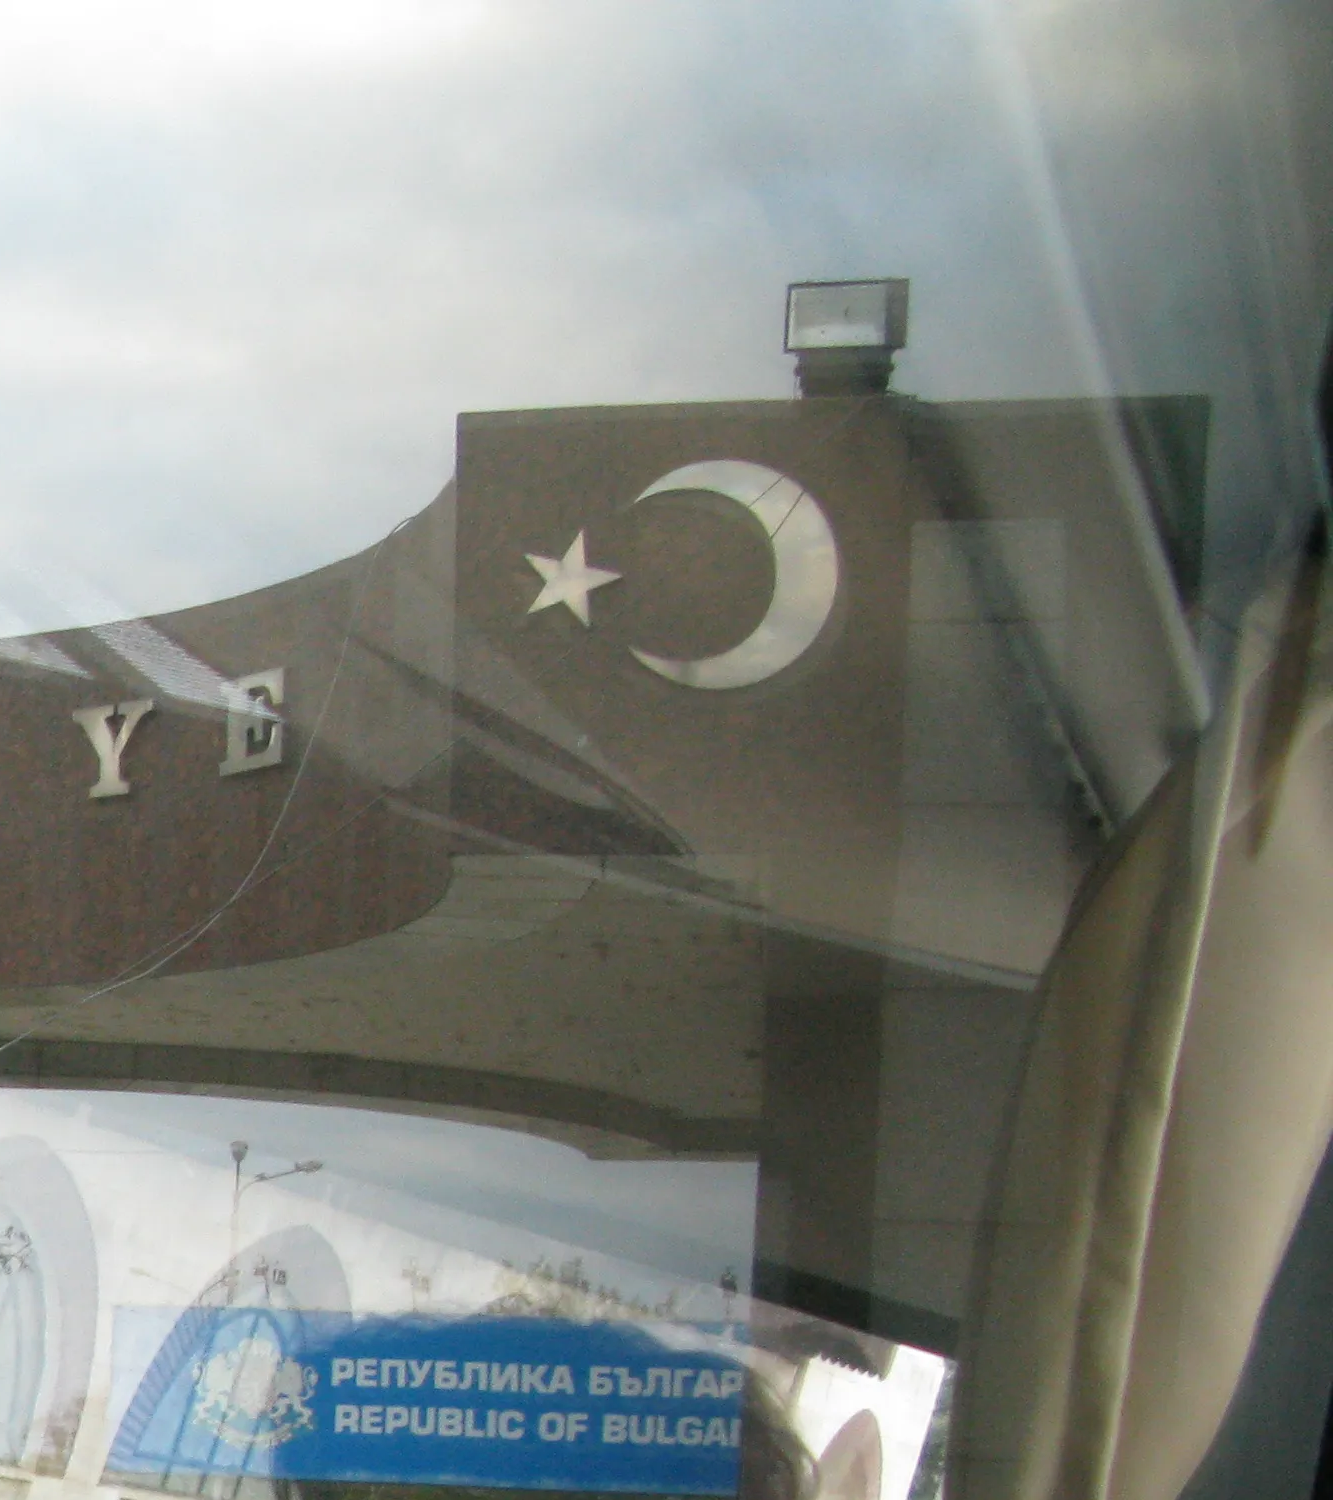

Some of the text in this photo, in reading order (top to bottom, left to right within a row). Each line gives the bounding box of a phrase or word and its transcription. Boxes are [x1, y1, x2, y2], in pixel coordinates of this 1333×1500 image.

[331, 1357, 575, 1396] РЕПУБЛИКА
[333, 1403, 526, 1440] REPUBLIC
[538, 1412, 588, 1442] OF
